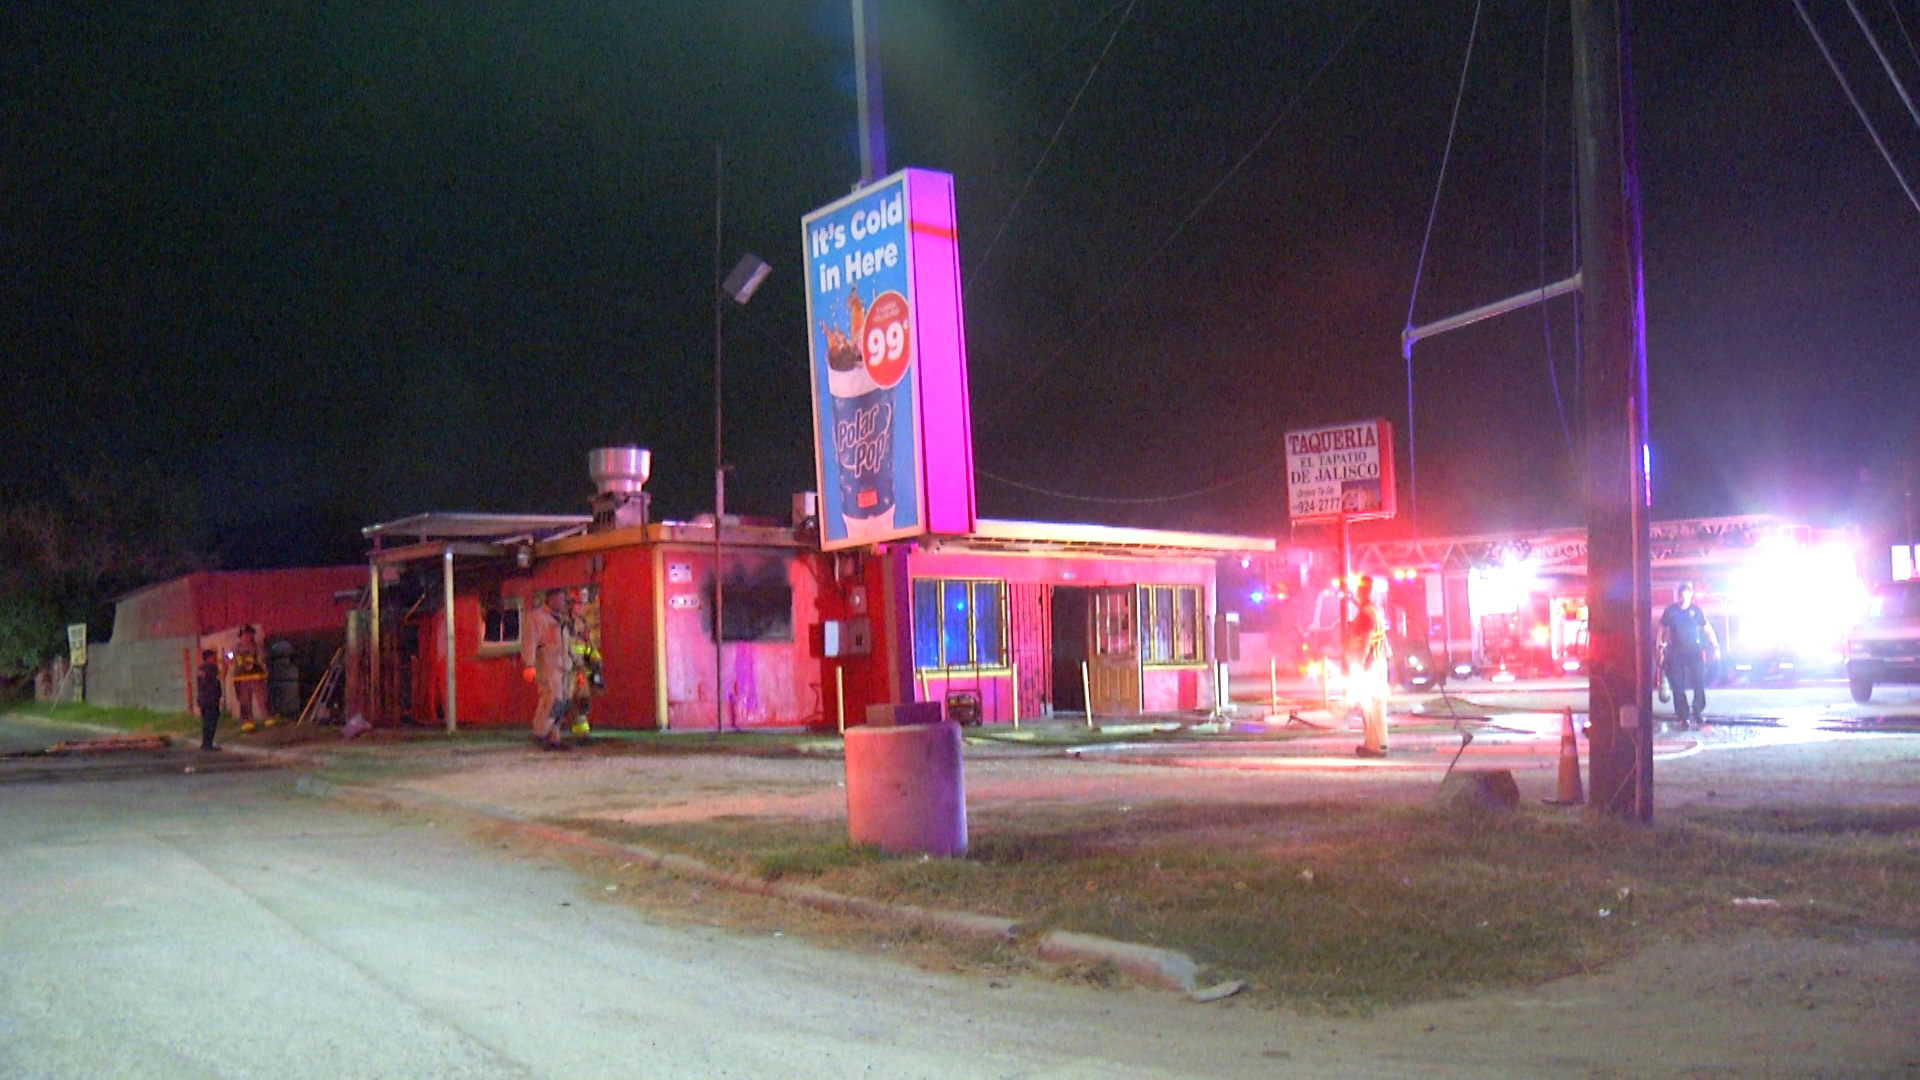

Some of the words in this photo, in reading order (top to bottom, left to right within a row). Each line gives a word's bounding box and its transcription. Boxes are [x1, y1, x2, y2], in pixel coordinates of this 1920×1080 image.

[812, 222, 846, 258] It's
[850, 191, 903, 241] Cold
[819, 263, 840, 293] in
[845, 242, 899, 284] Here
[1288, 426, 1377, 456] TAQUERIA
[1291, 470, 1311, 484] DE
[1315, 463, 1378, 481] JALISCO
[1300, 457, 1313, 468] EL
[1319, 451, 1367, 466] TAPATIO
